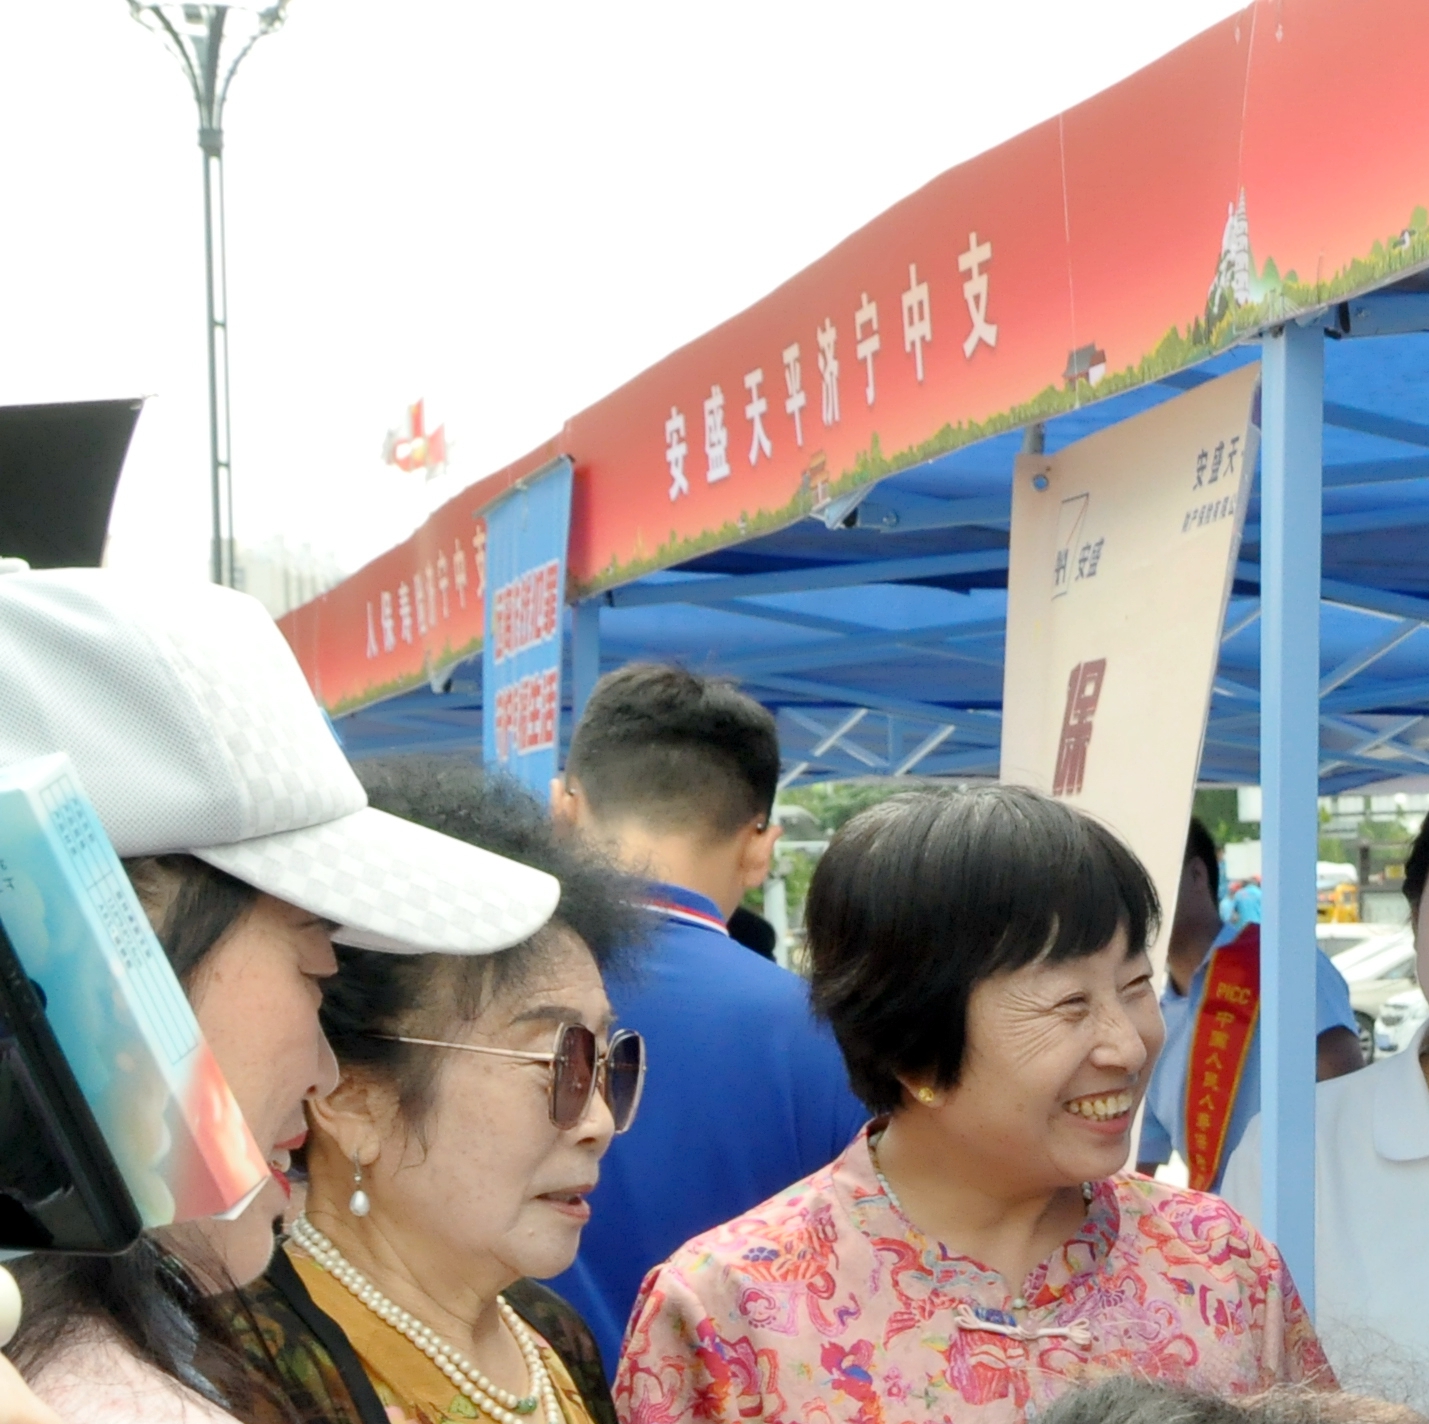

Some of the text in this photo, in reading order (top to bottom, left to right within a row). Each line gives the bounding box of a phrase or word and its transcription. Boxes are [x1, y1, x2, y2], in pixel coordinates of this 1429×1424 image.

[664, 231, 998, 503] 安盛天平济宁中支
[1192, 436, 1245, 491] 安盛天
[1216, 981, 1251, 1005] PICC
